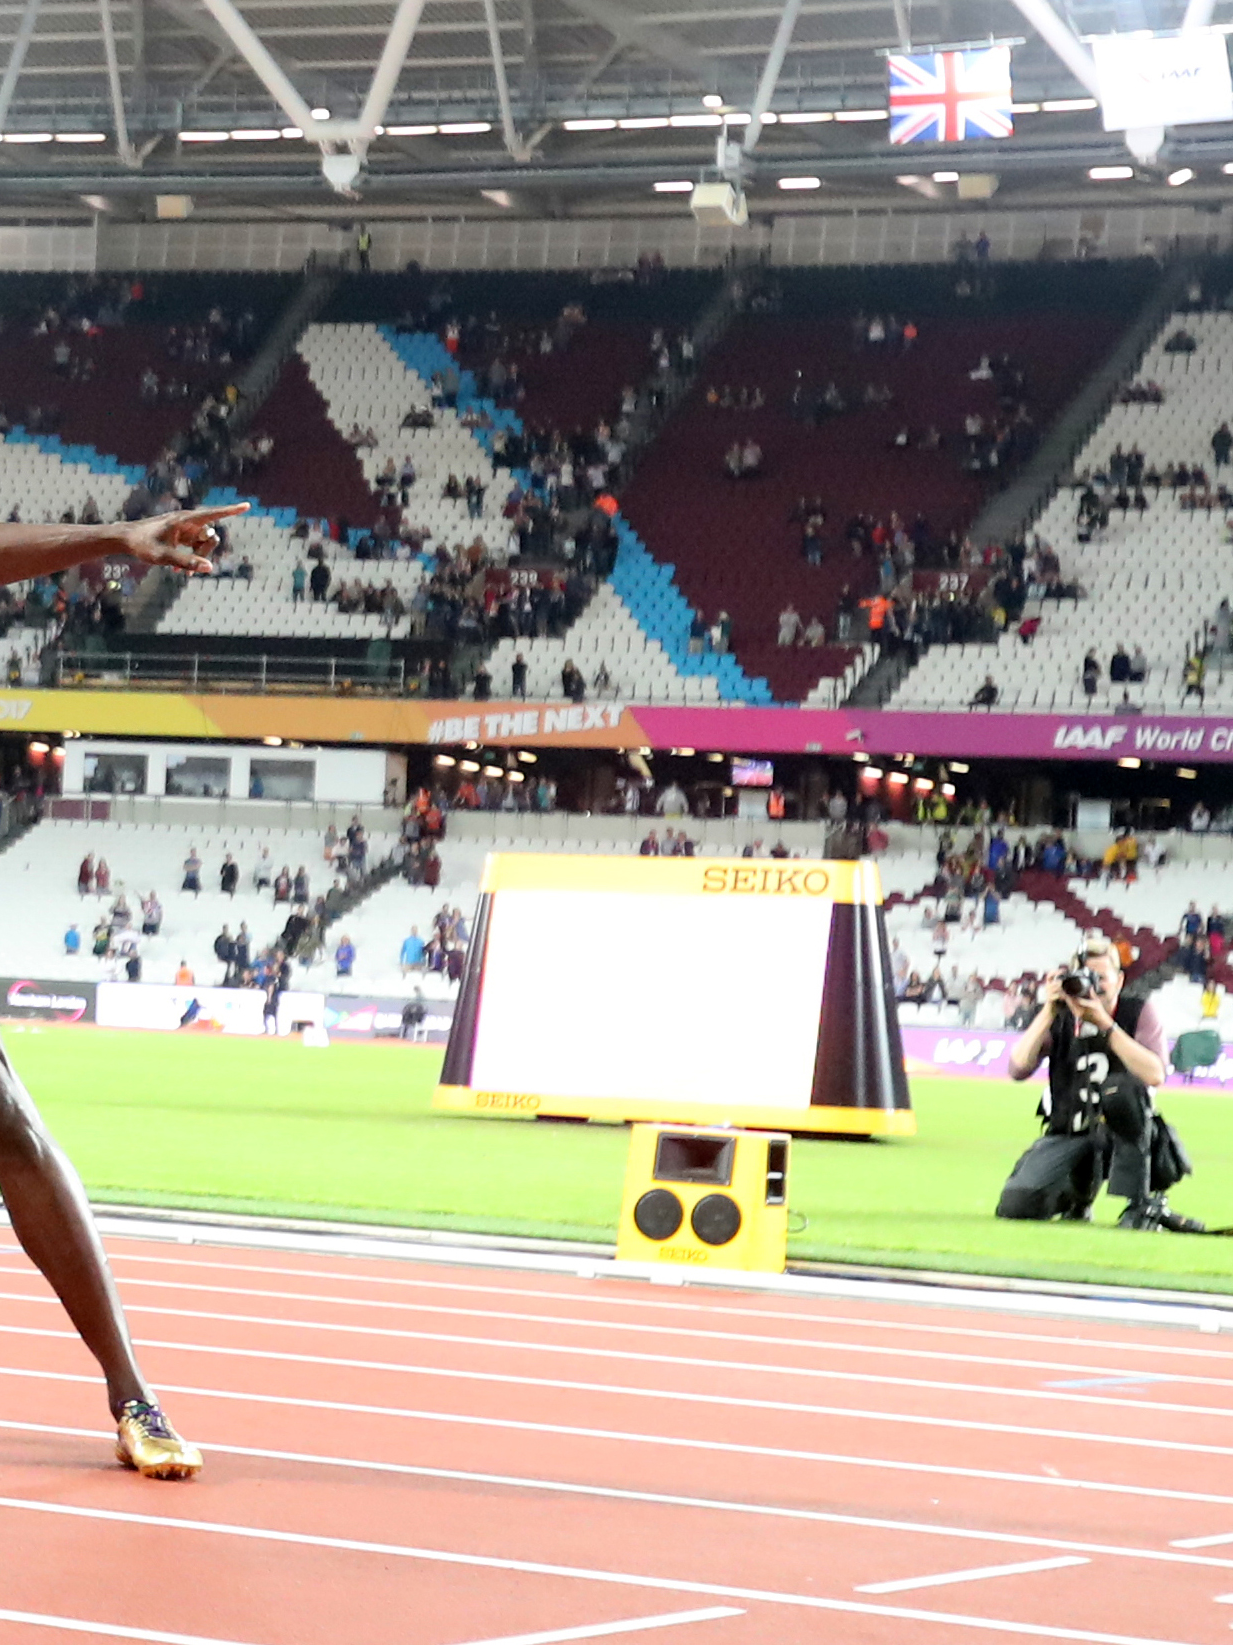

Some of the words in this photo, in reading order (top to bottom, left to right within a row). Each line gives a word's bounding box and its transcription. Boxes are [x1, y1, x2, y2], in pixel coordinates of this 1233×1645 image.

[428, 715, 481, 744] #BE
[484, 711, 540, 738] THE
[543, 704, 625, 733] NEXT
[1053, 725, 1128, 750] IAAF
[1135, 725, 1206, 751] World
[702, 866, 830, 896] SEIKO
[476, 1092, 542, 1111] SEIKO
[658, 1246, 709, 1263] SEIKO
